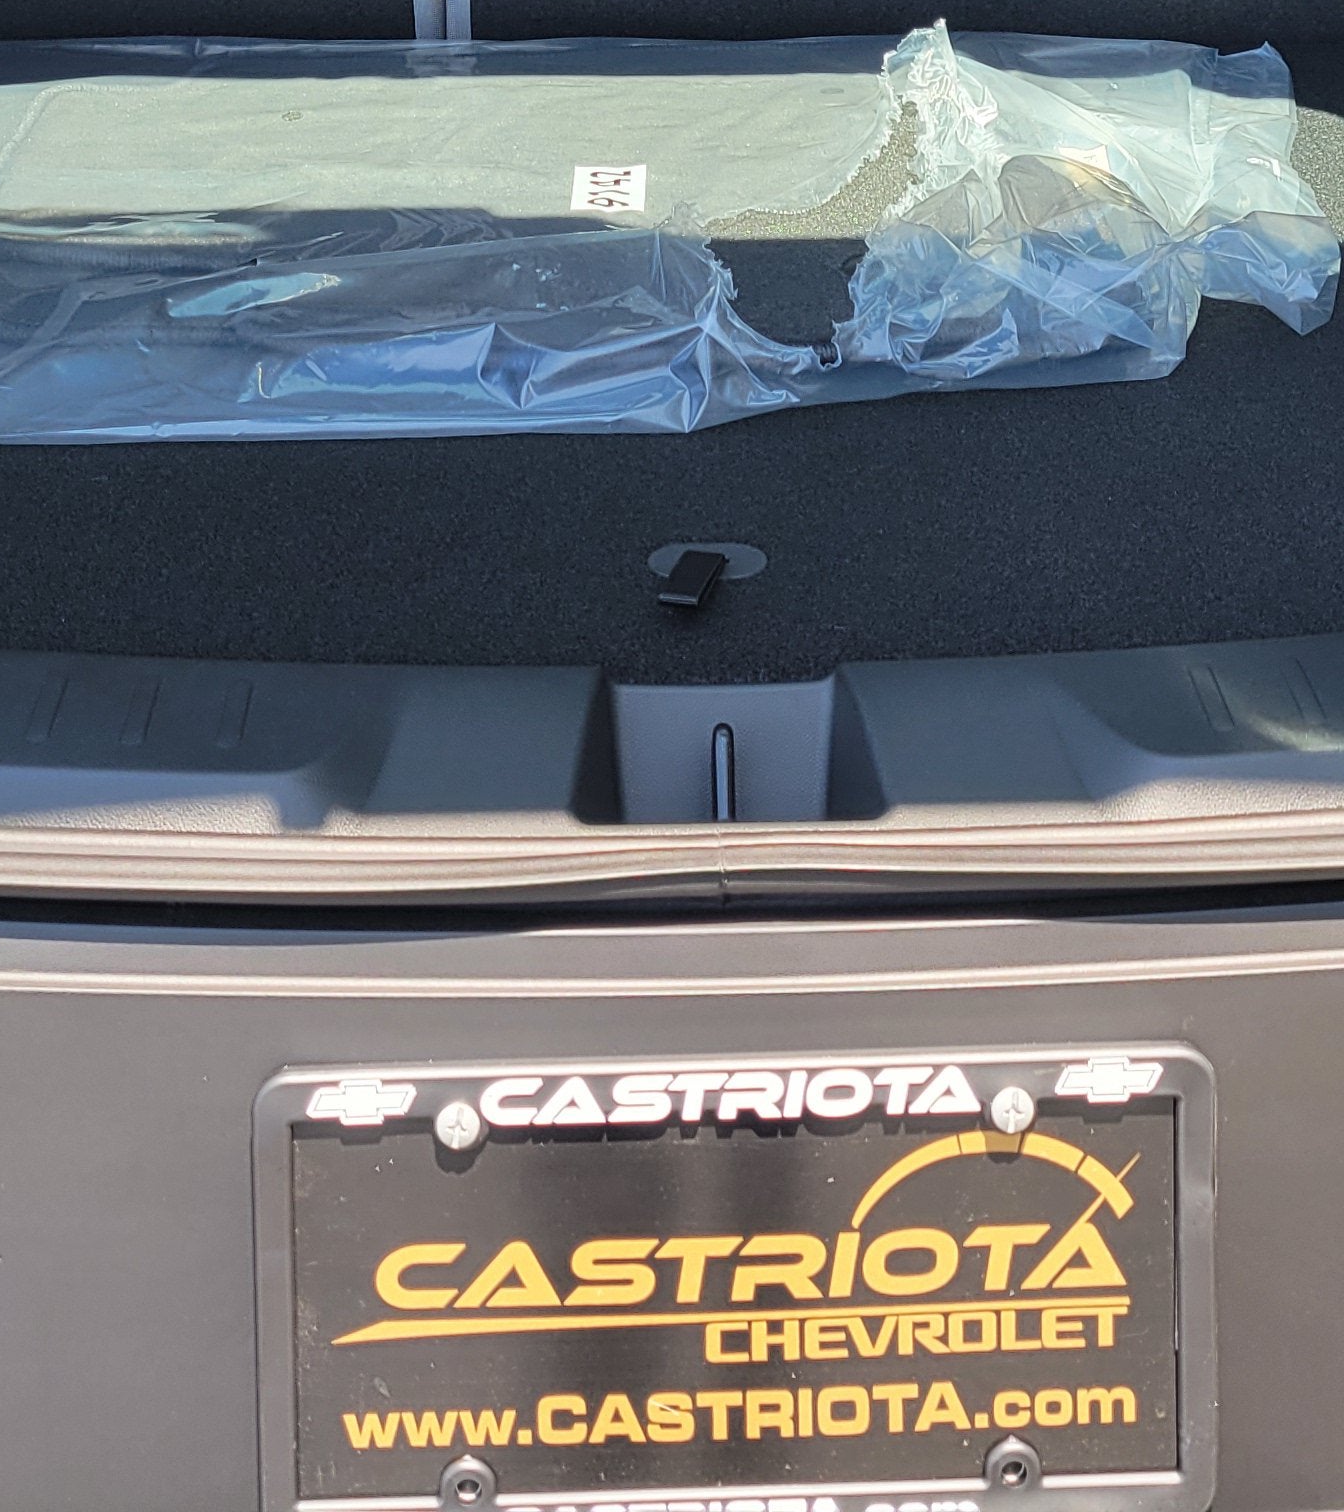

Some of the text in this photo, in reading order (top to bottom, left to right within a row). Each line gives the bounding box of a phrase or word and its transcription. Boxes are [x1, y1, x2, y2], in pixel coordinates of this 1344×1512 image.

[478, 1064, 982, 1126] CASTRIOTA
[373, 1221, 1128, 1310] CASTRIOTA
[704, 1307, 1129, 1365] CHEVROLET
[341, 1379, 1140, 1451] www.CASTRIOTA.com
